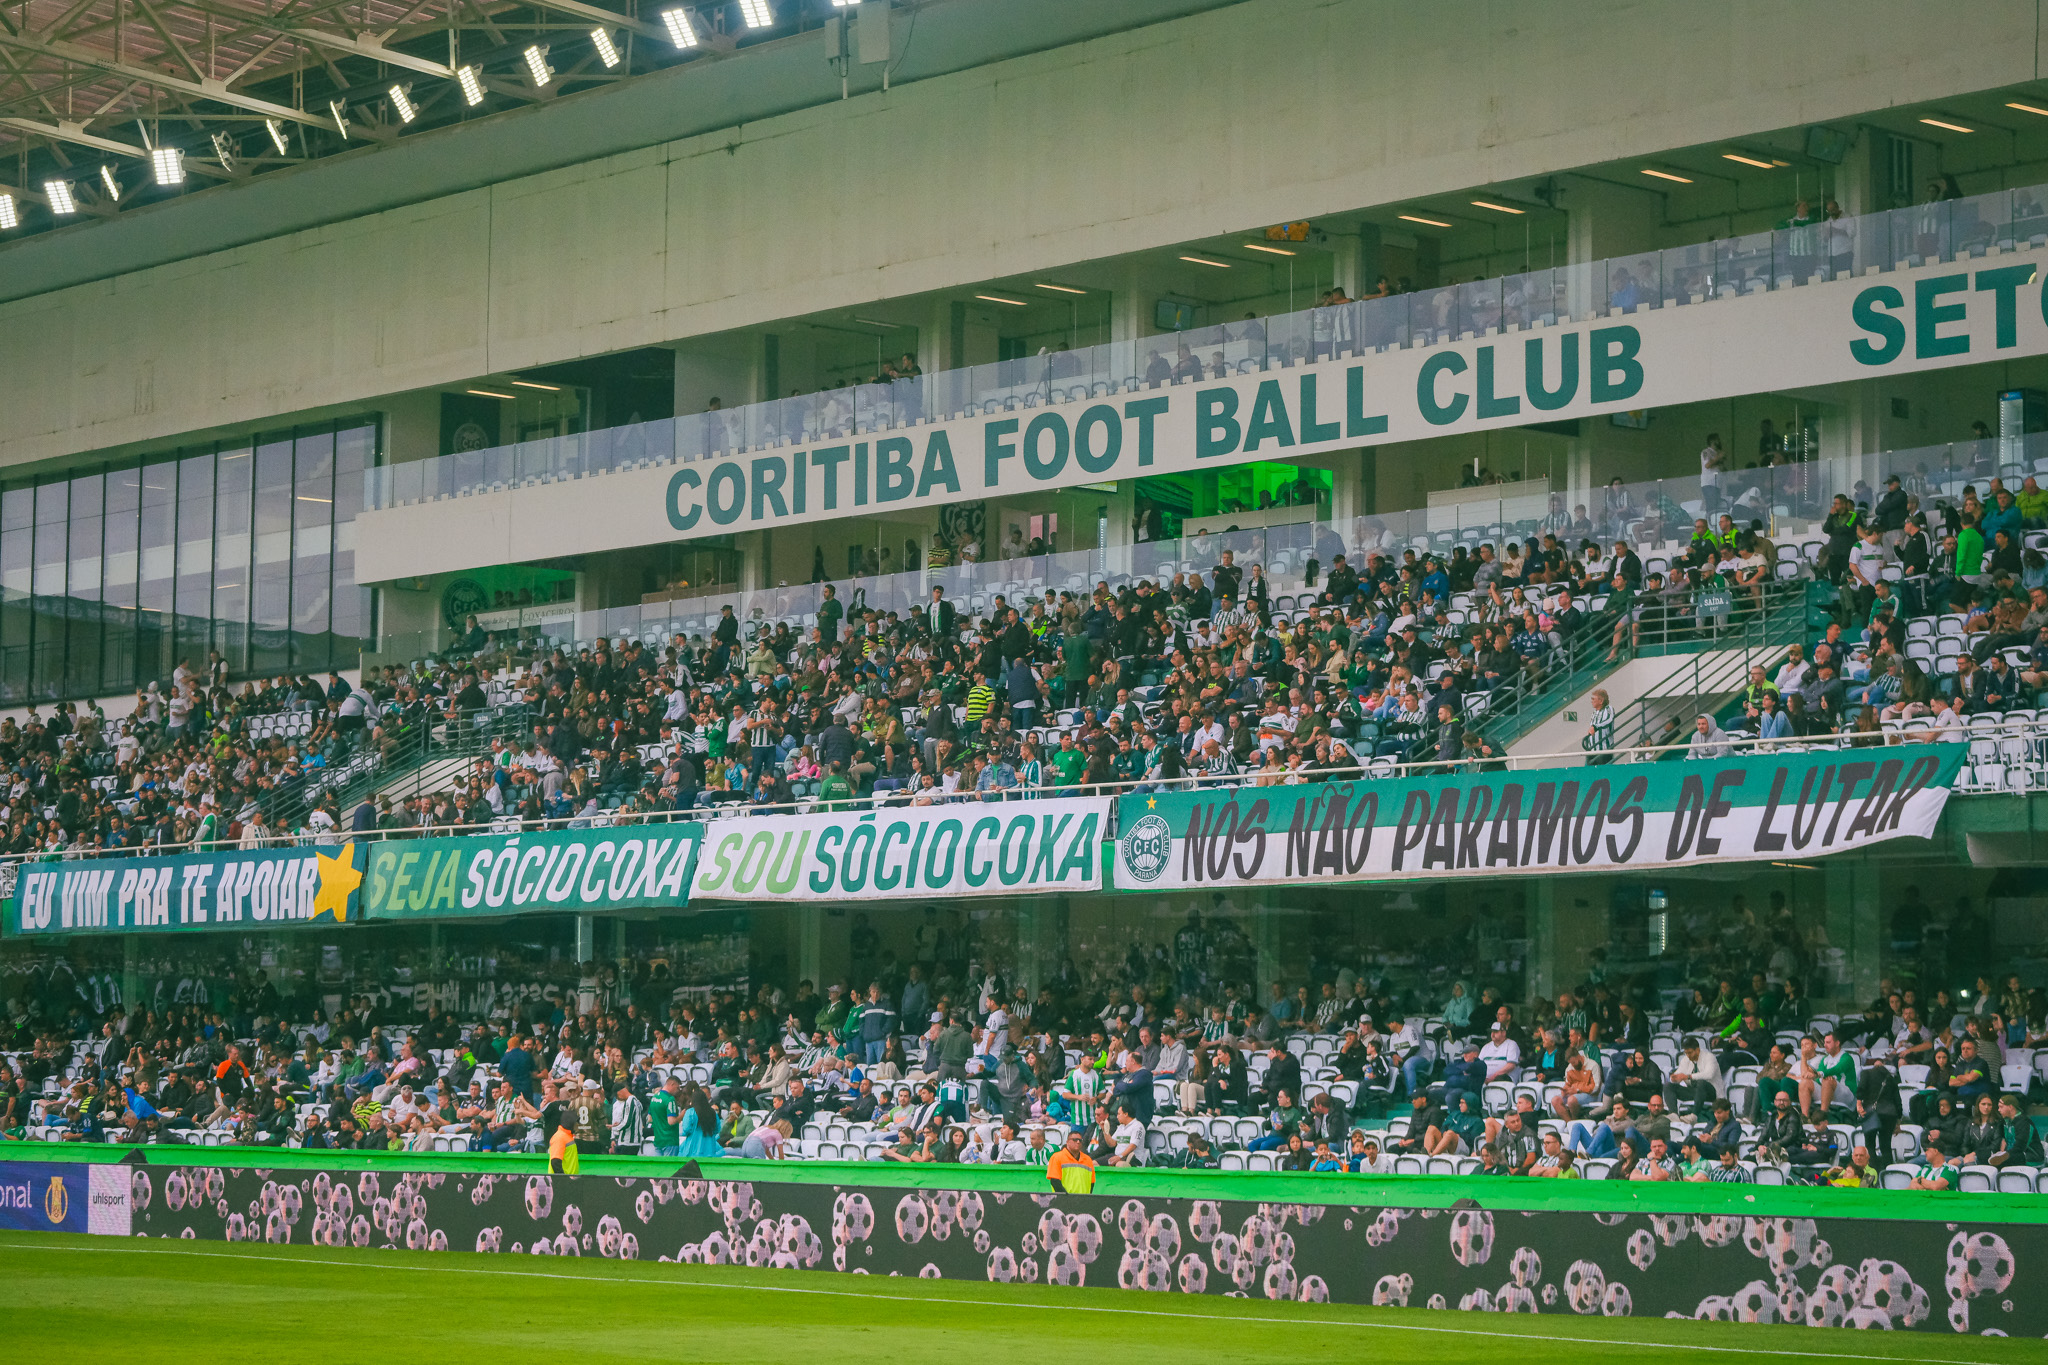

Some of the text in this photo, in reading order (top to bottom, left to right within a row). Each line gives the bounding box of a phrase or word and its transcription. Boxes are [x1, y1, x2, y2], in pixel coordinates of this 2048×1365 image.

[1849, 263, 2048, 365] SET
[665, 325, 1644, 531] CORITIBA FOOT BALL CLUB
[523, 607, 575, 622] COXACEIROS
[1704, 596, 1724, 606] SAÍDA
[1124, 816, 1170, 858] CORITIBA FOOT BALL CLUB
[1182, 755, 1941, 881] NÓS NÃO PARAMOS DE LUTAR
[370, 837, 693, 911] SEJA SÓCIOCOXA
[700, 813, 1099, 894] SOU SÓCIOCOXA
[1133, 839, 1160, 856] CFC
[22, 857, 319, 929] EU VIM PRA TE APOIAR
[579, 1105, 589, 1125] 8
[93, 1192, 124, 1207] uhlsport
